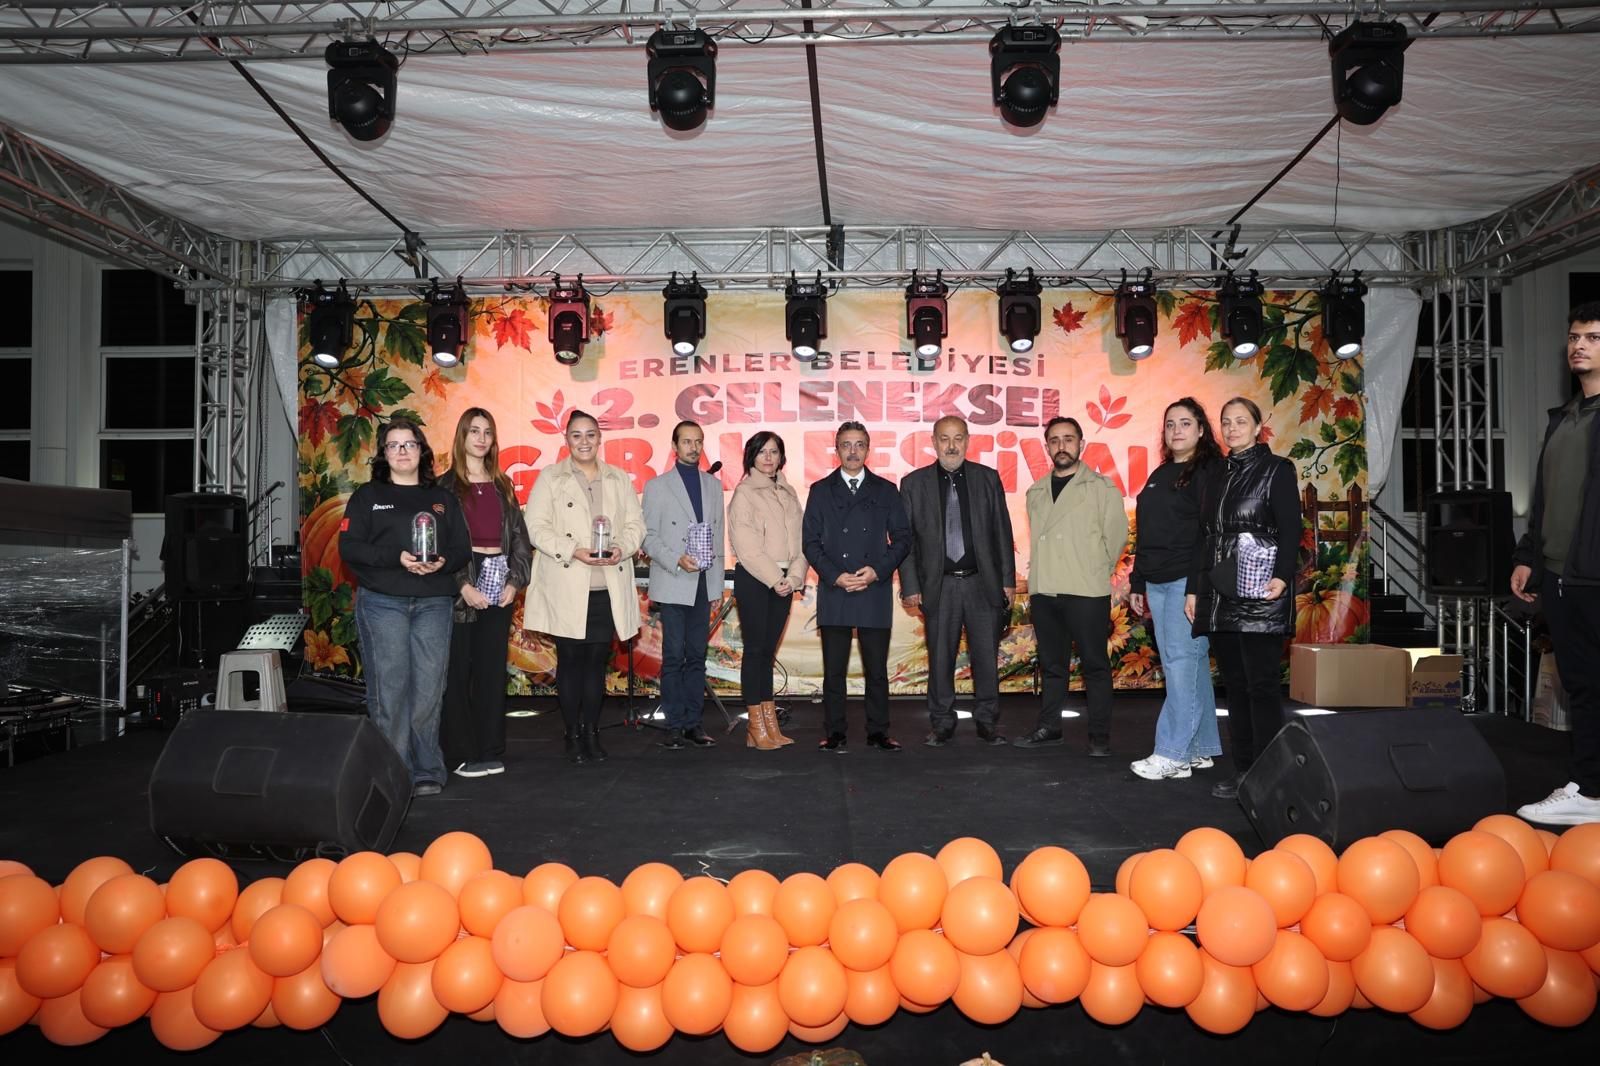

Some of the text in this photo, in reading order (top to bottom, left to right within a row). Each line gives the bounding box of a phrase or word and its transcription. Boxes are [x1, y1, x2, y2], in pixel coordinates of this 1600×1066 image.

[619, 347, 1045, 380] ERENLER BELEDİYESİ
[591, 387, 661, 431] 2.
